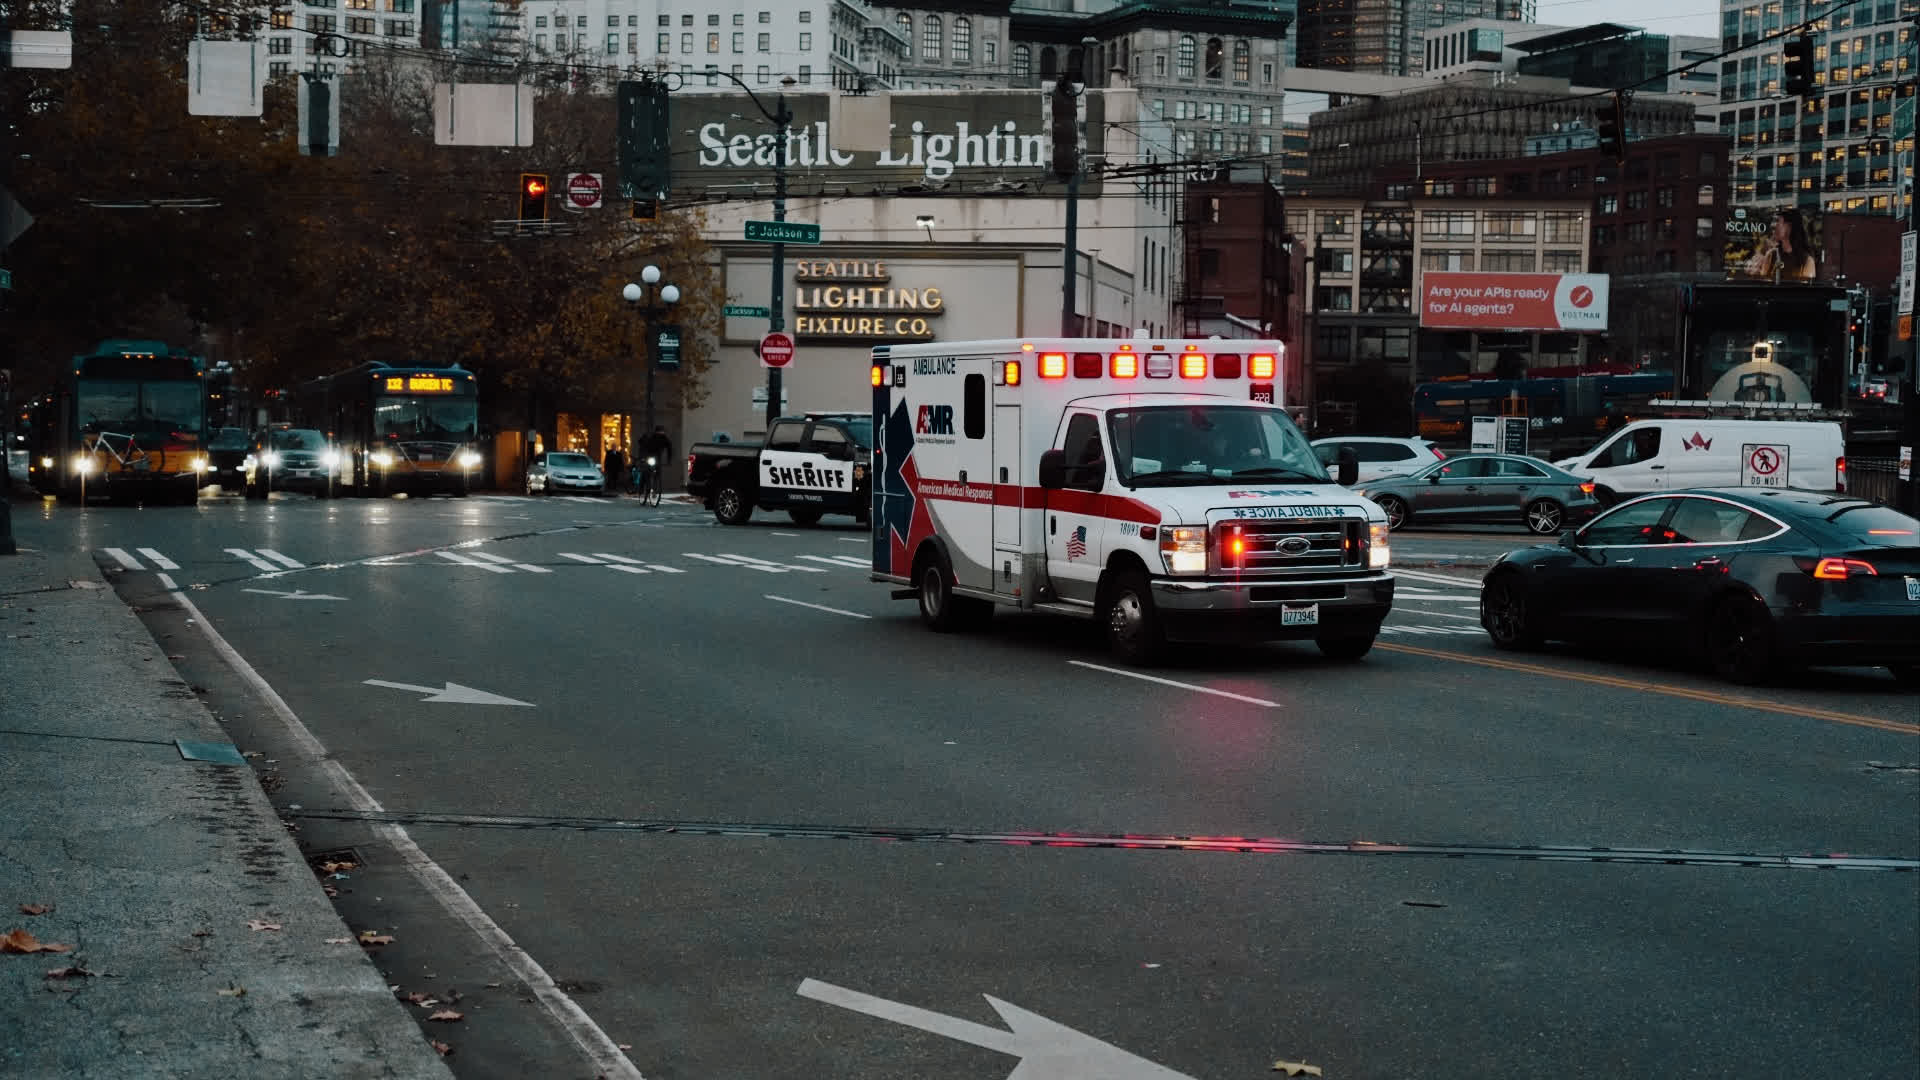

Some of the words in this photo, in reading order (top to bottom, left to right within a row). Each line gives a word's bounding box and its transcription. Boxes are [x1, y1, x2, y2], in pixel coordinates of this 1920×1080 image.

[749, 225, 756, 236] S
[760, 226, 803, 239] Jackson
[796, 260, 887, 278] SEATTLE
[796, 286, 942, 309] LIGHTING
[1430, 285, 1451, 297] Are
[1454, 288, 1482, 300] your
[1484, 286, 1511, 298] APIs
[1513, 287, 1549, 301] ready
[1430, 302, 1447, 313] for
[1449, 303, 1462, 313] AI
[1464, 303, 1514, 317] agents?
[1562, 311, 1600, 319] POSTMAN
[796, 316, 886, 335] FIXTURE
[894, 317, 931, 336] CO.
[913, 357, 956, 376] AMBULANCE
[916, 405, 954, 435] AMR
[769, 466, 845, 488] SHERIFF
[1751, 476, 1760, 485] DO
[1764, 477, 1778, 485] NOT
[917, 481, 943, 496] American
[943, 482, 965, 497] Medical
[965, 485, 993, 501] Response
[1908, 583, 1920, 595] 02
